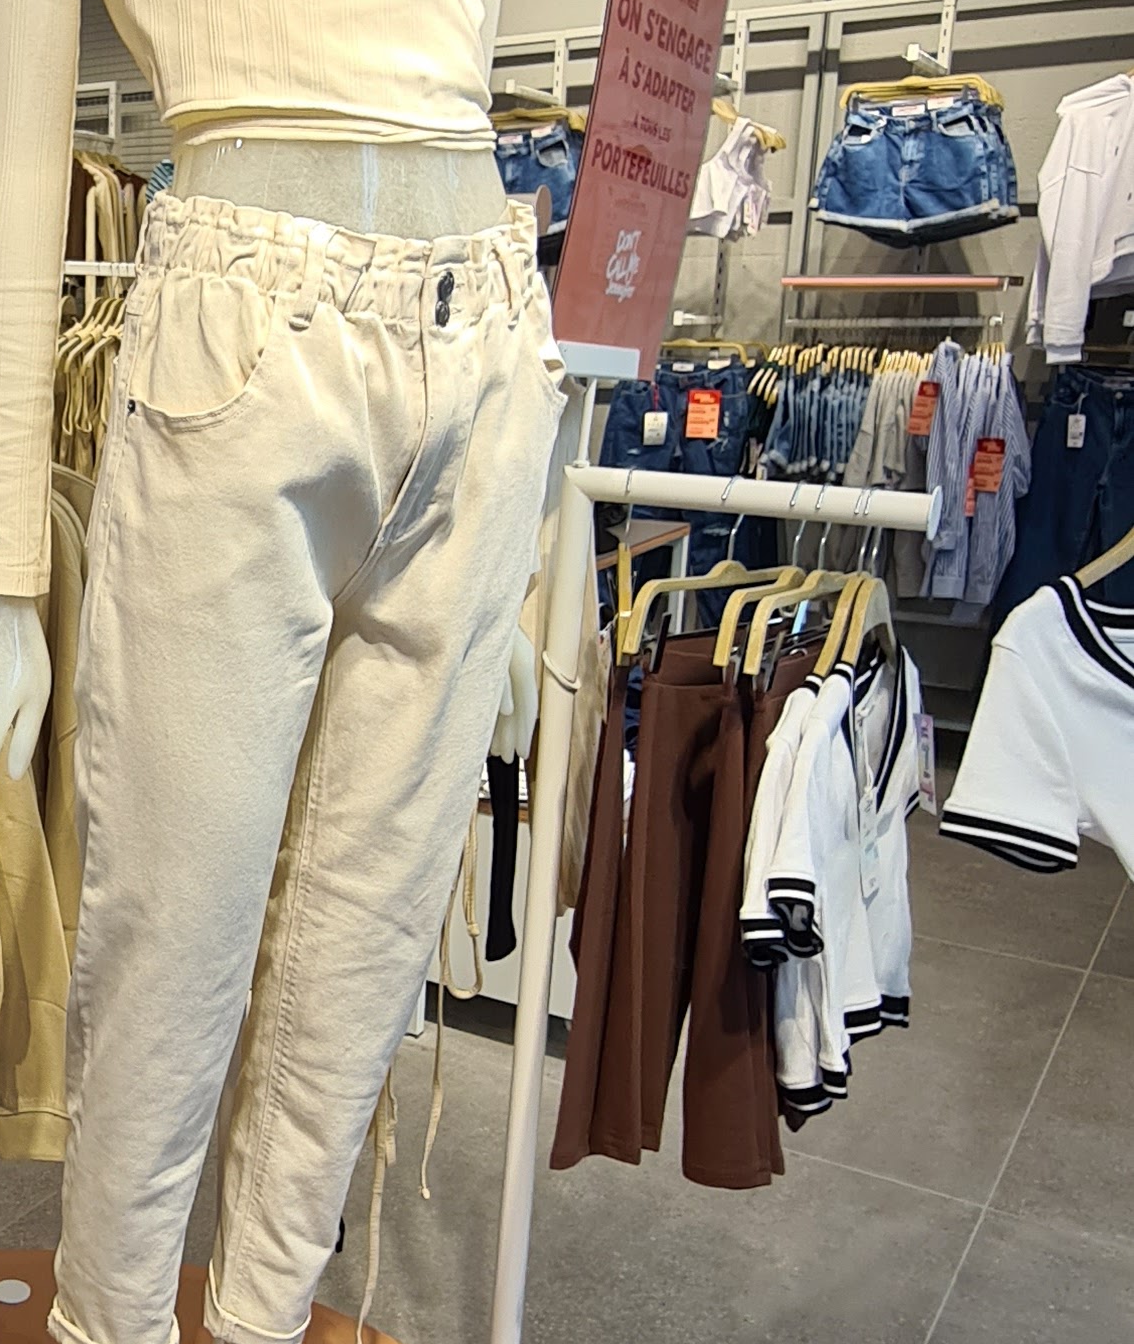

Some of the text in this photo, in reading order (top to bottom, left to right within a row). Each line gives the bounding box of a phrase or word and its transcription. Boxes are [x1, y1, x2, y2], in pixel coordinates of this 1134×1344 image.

[644, 8, 713, 75] S'ENGAGE
[618, 47, 696, 116] À S'ADAPTER
[591, 138, 691, 200] PORTEFEUILLES
